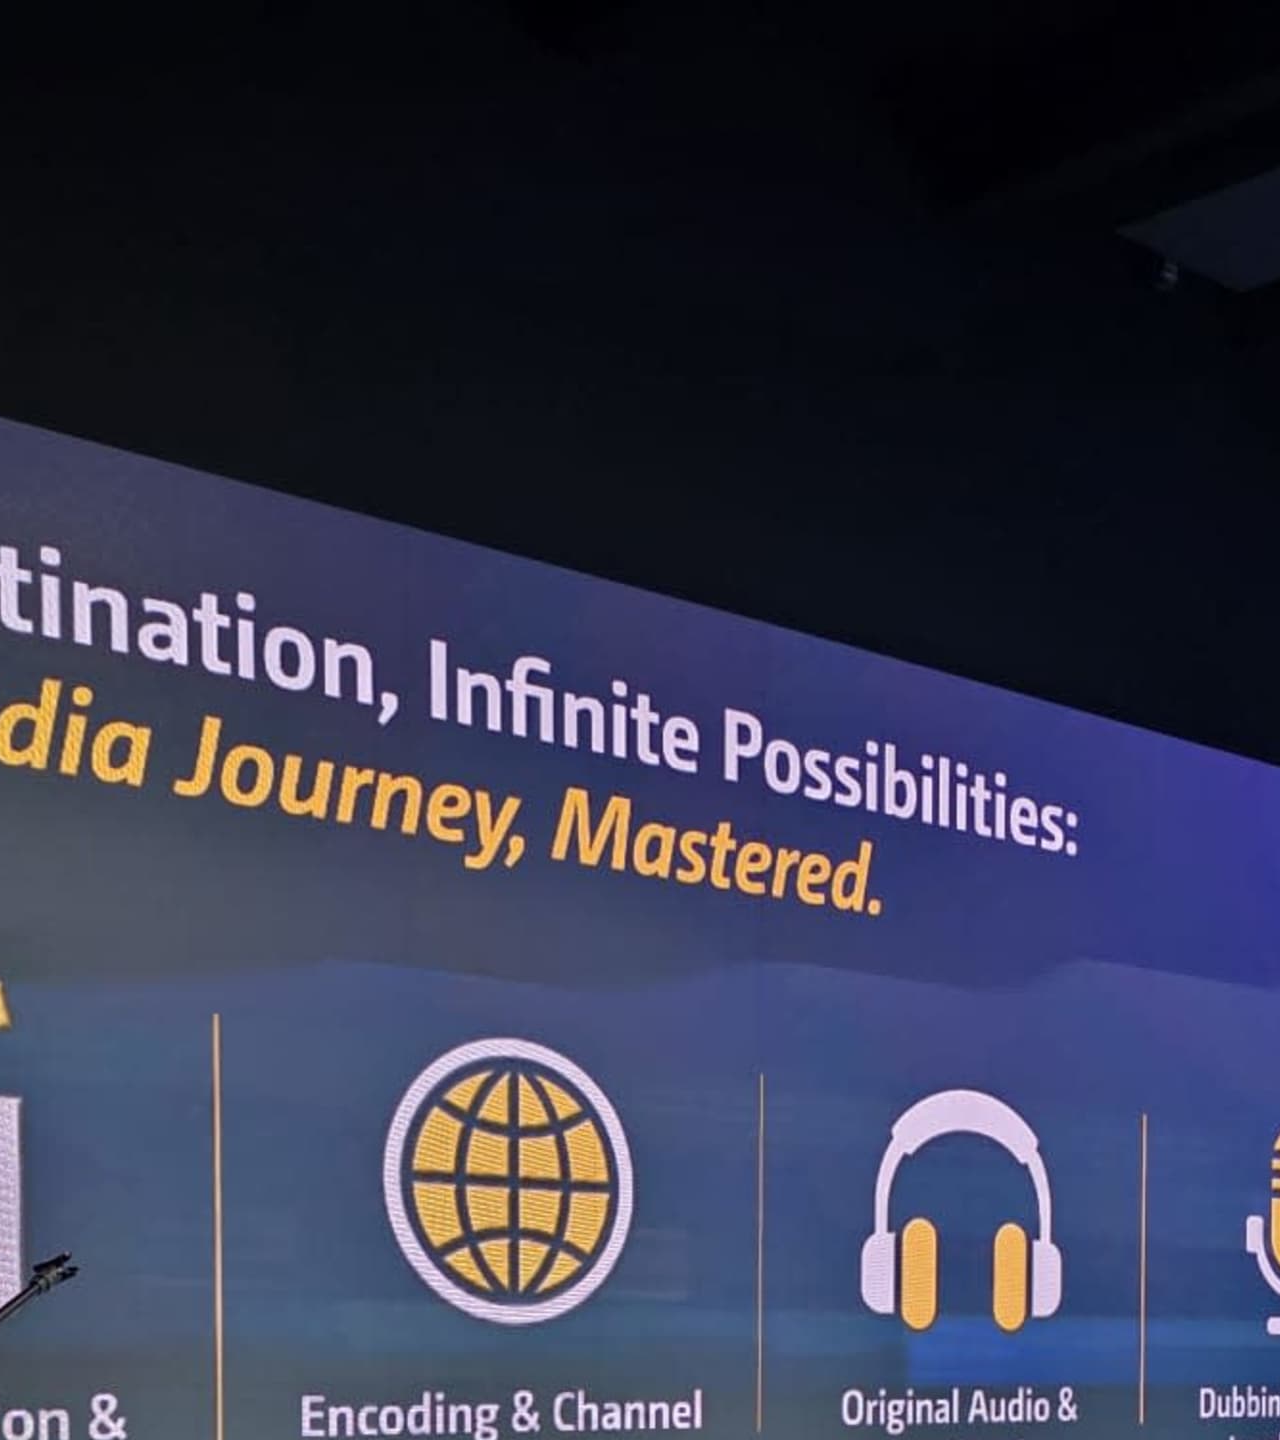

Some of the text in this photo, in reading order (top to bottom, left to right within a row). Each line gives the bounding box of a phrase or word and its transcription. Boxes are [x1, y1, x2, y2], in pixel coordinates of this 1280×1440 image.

[429, 638, 699, 773] Infinite
[723, 706, 1078, 856] Possibilities:
[174, 715, 526, 870] Journey,
[551, 787, 883, 915] Mastered.
[88, 1393, 127, 1440] &
[511, 1390, 541, 1432] &
[553, 1389, 703, 1432] Channel
[841, 1386, 1078, 1434] Original Audio &
